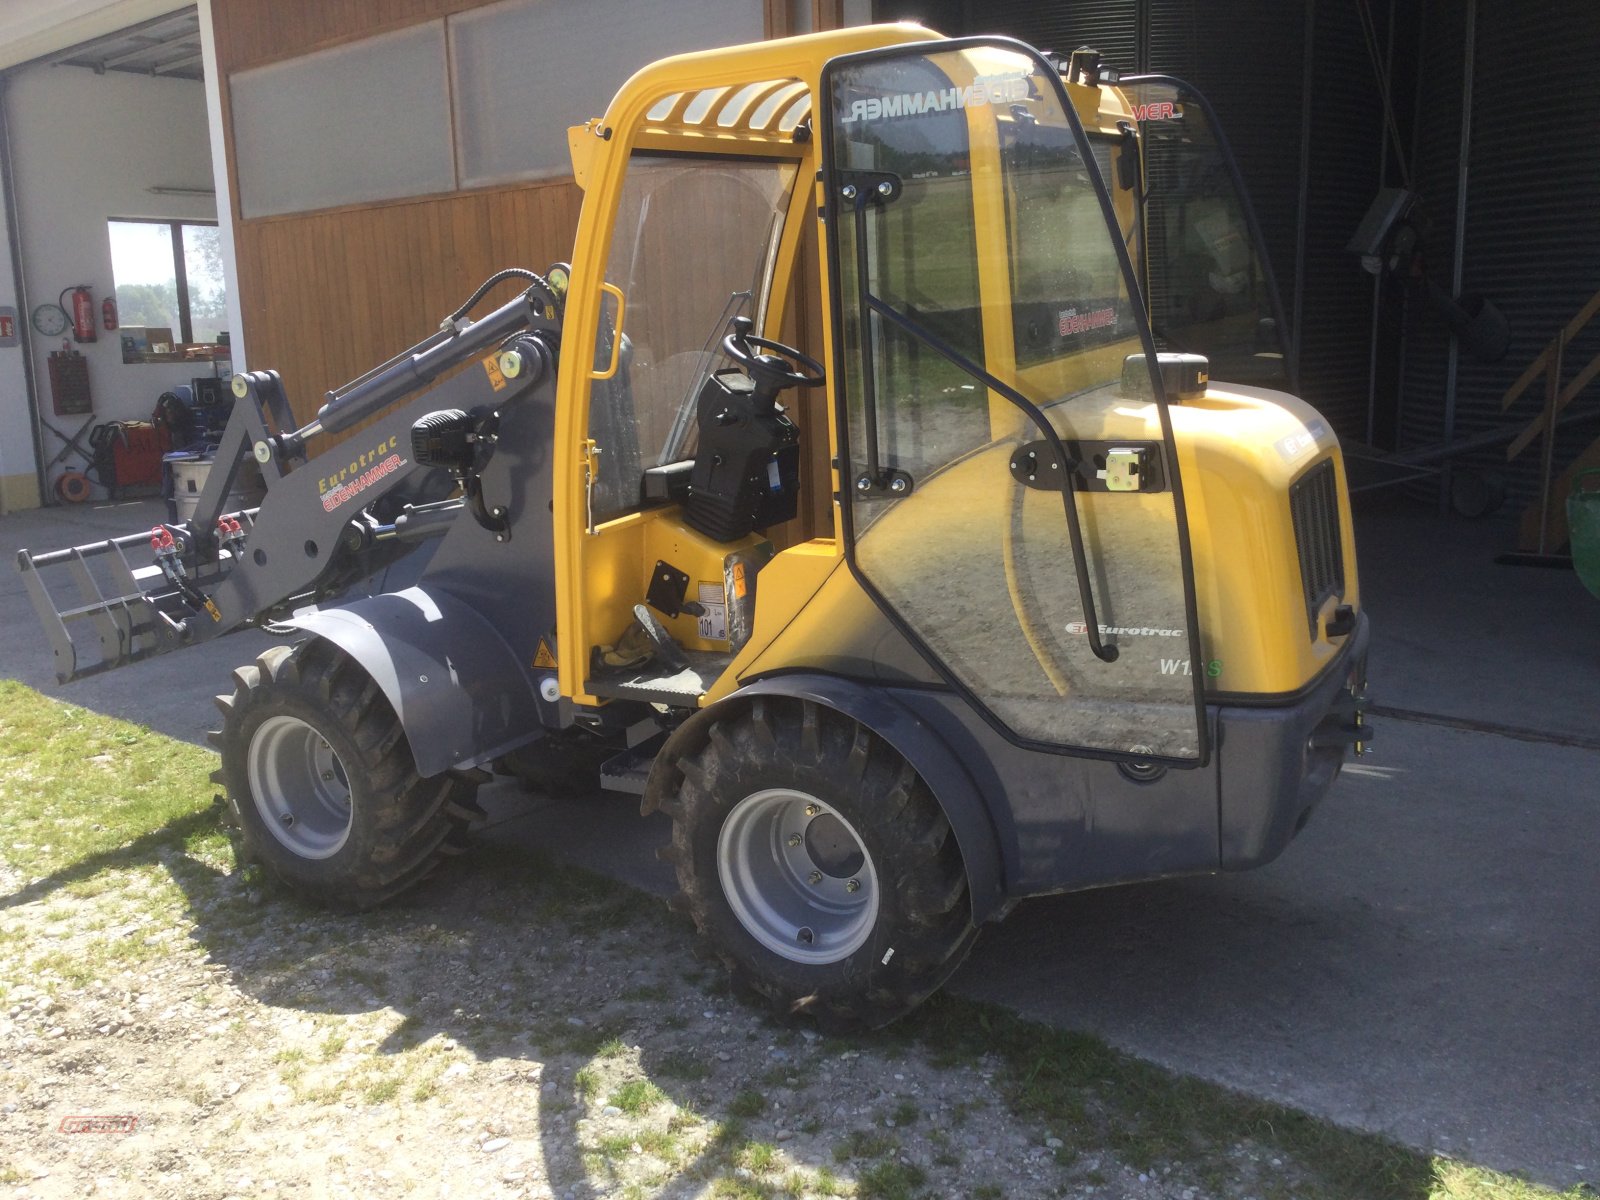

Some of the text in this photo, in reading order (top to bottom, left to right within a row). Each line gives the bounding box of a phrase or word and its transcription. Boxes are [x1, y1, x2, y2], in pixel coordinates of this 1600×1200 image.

[318, 436, 397, 493] Eurotrac
[322, 454, 401, 512] EIDENHAMMER
[1097, 624, 1183, 637] Eurotrac
